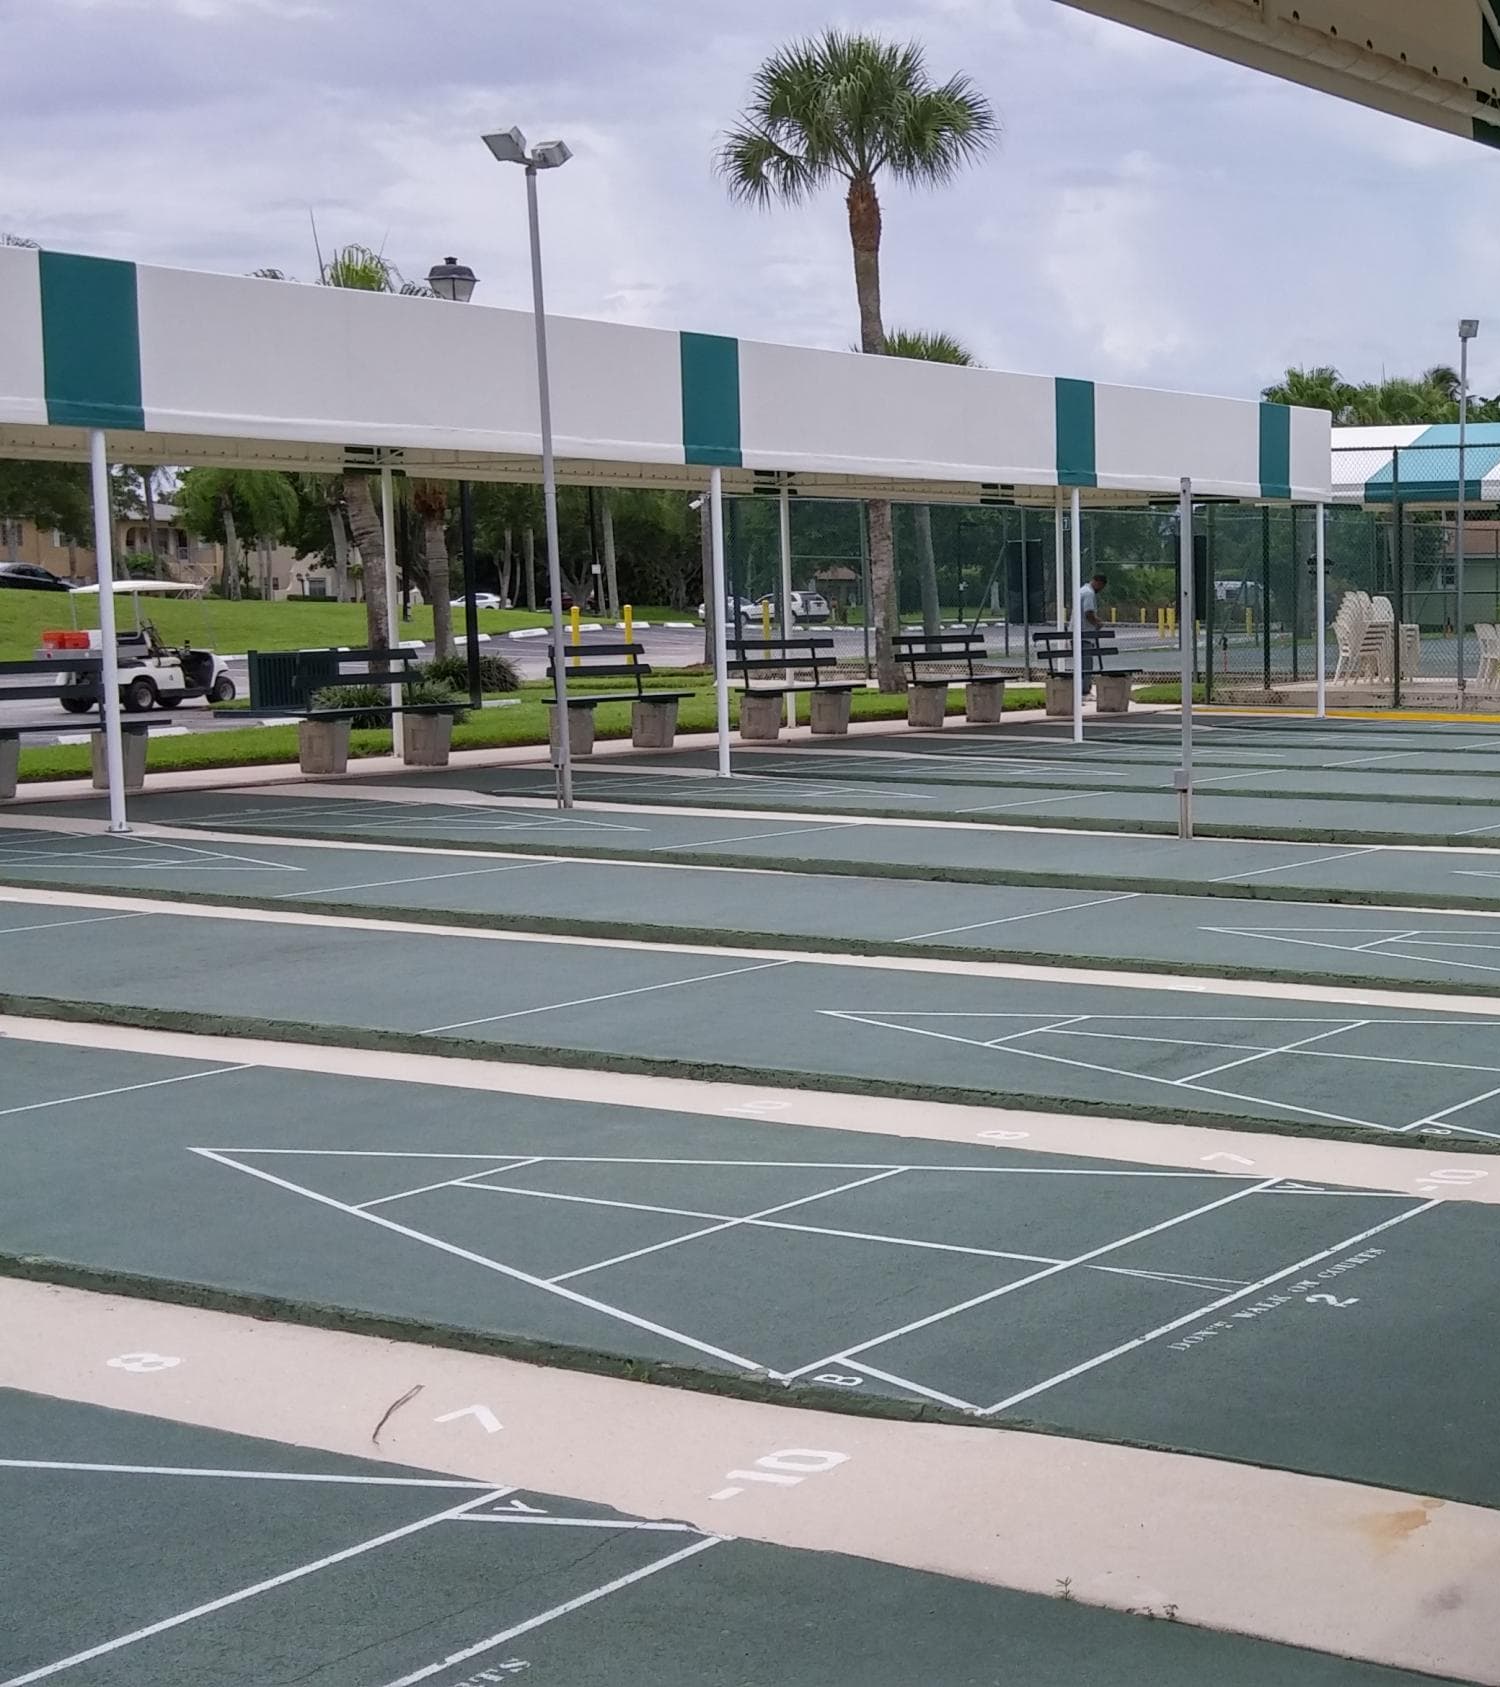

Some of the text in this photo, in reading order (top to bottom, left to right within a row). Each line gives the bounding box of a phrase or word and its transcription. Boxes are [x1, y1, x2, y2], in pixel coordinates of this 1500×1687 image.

[1231, 1293, 1293, 1319] WALK
[1287, 1279, 1321, 1294] ON
[1317, 1247, 1386, 1280] COURTS
[1304, 1293, 1361, 1308] 2
[106, 1352, 182, 1373] 8
[812, 1373, 864, 1387] B
[433, 1404, 504, 1433] 7
[492, 1499, 549, 1514] Y
